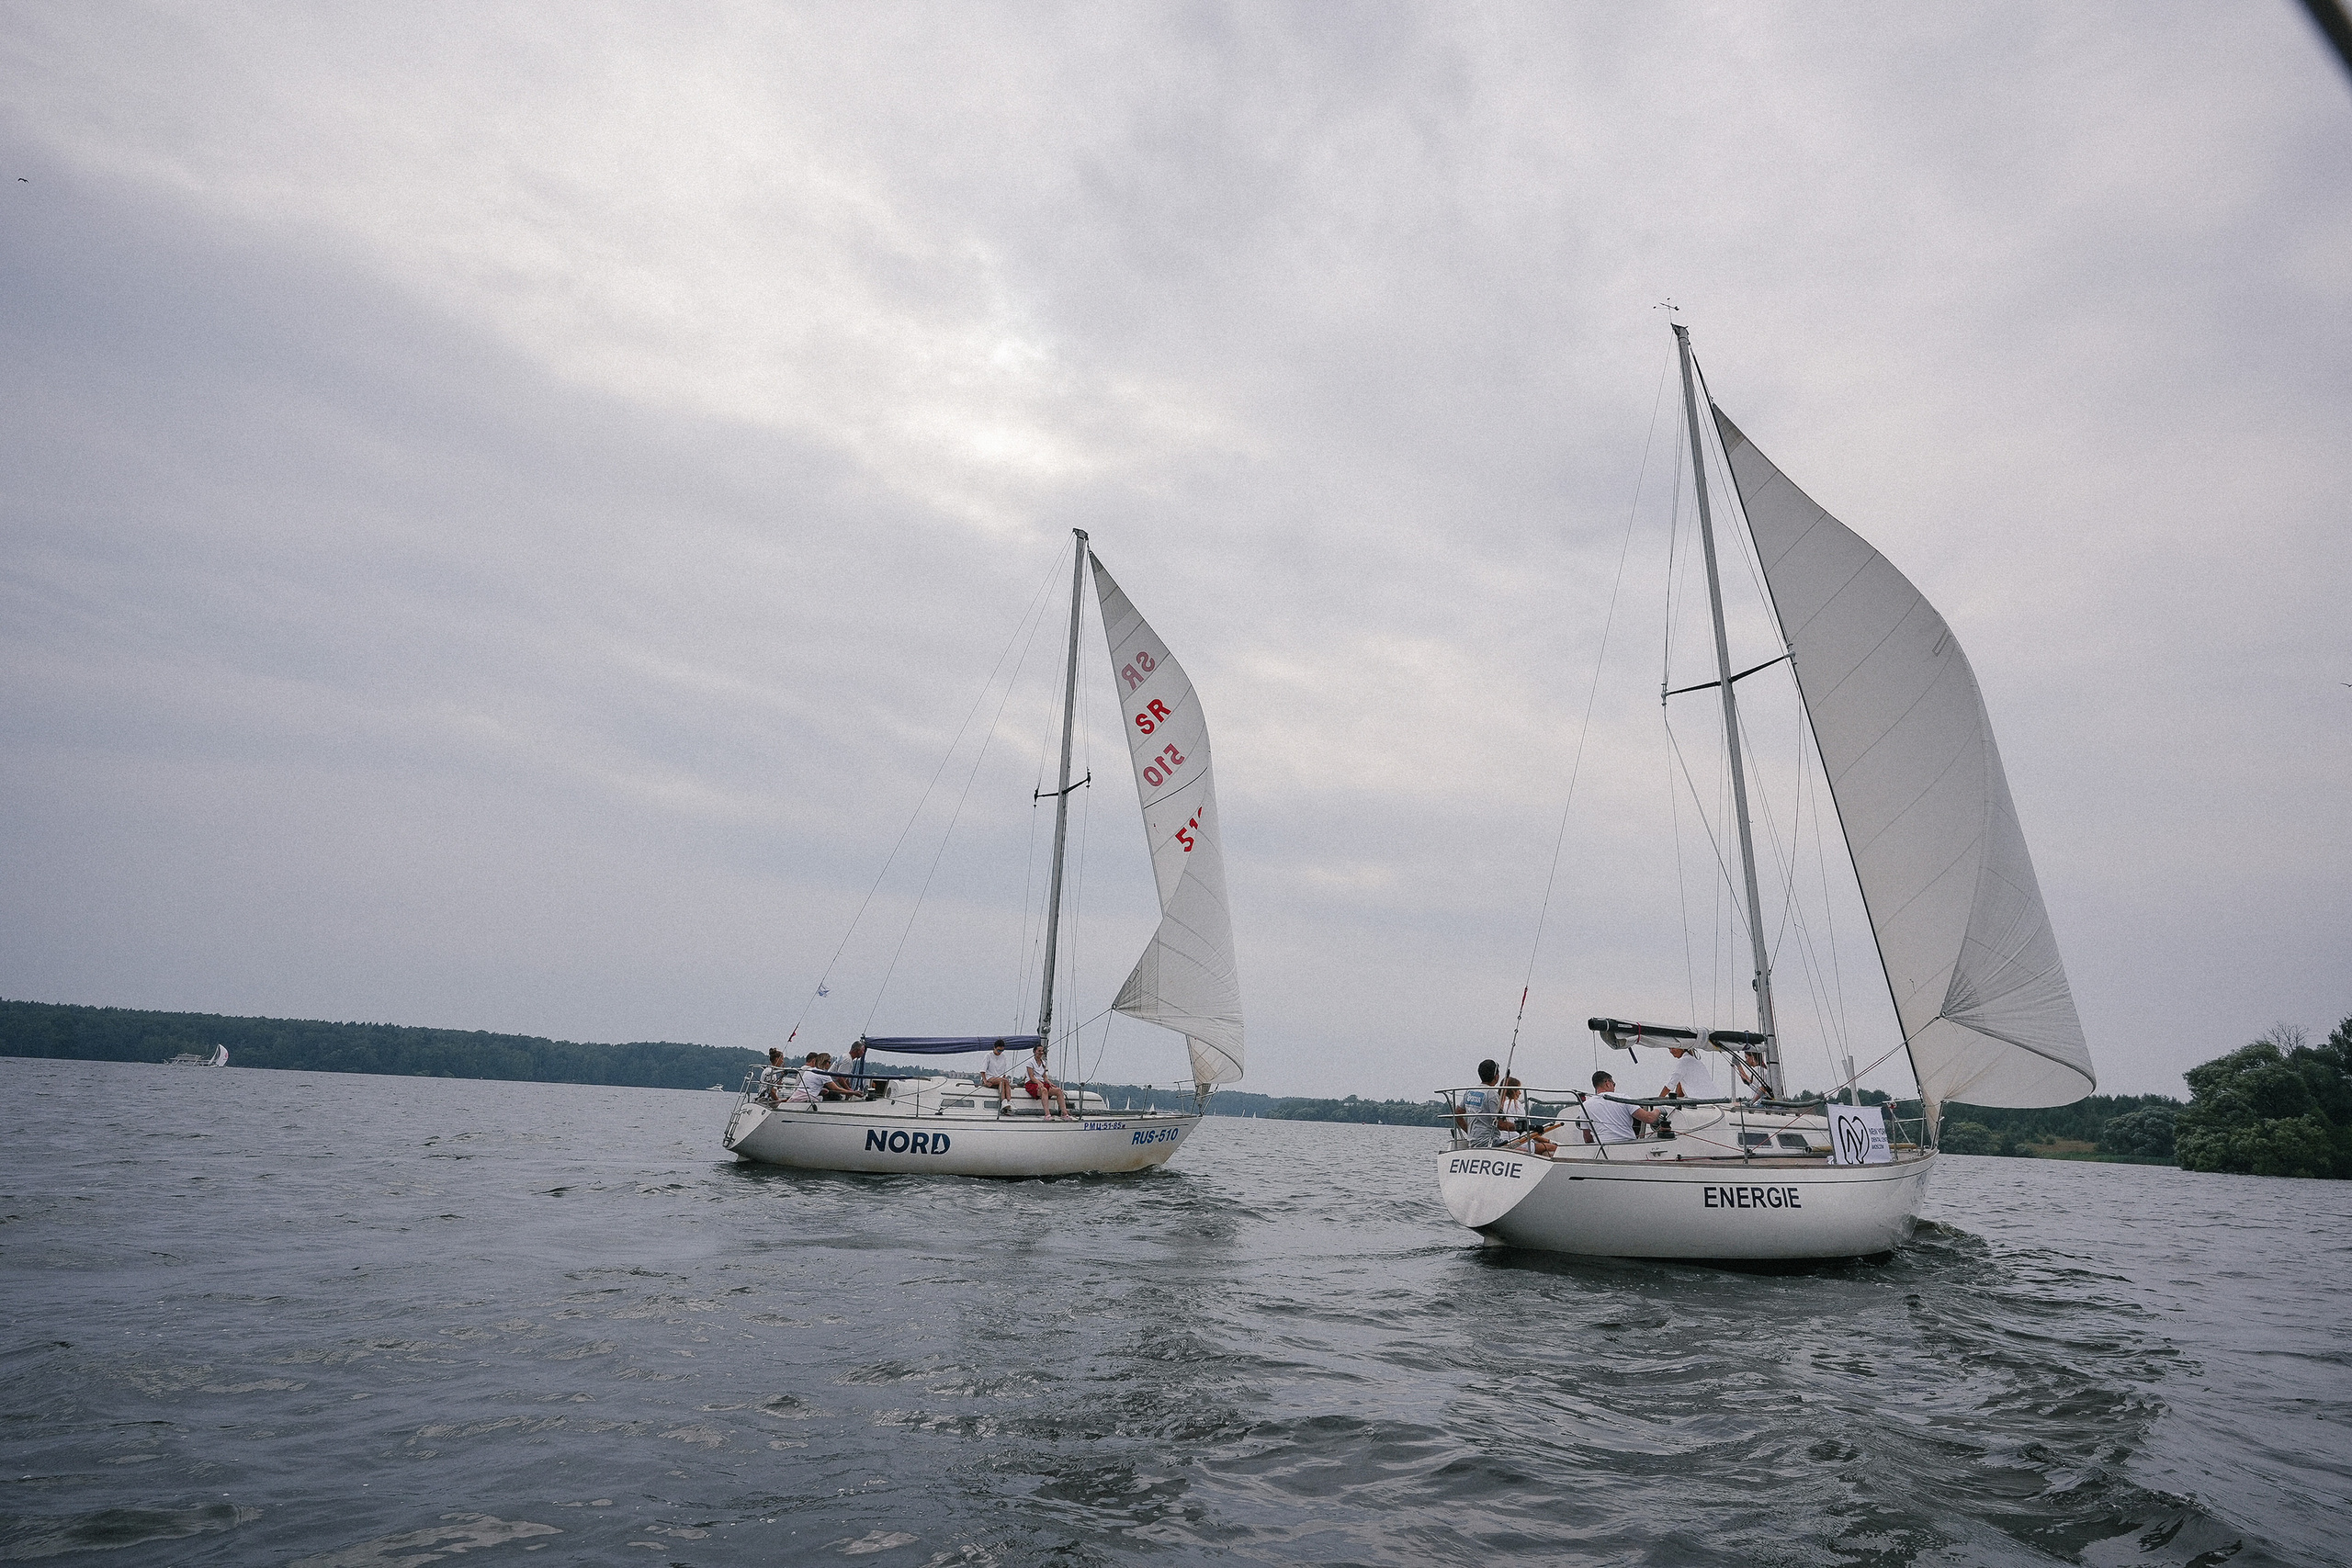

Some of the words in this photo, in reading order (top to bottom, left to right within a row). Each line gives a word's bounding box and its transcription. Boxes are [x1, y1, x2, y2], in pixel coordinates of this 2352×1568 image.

[1136, 699, 1170, 734] SR
[865, 1129, 951, 1155] NORD
[1132, 1128, 1179, 1145] RUS-510
[1449, 1159, 1523, 1179] ENERGIE
[1703, 1187, 1802, 1209] ENERGIE
